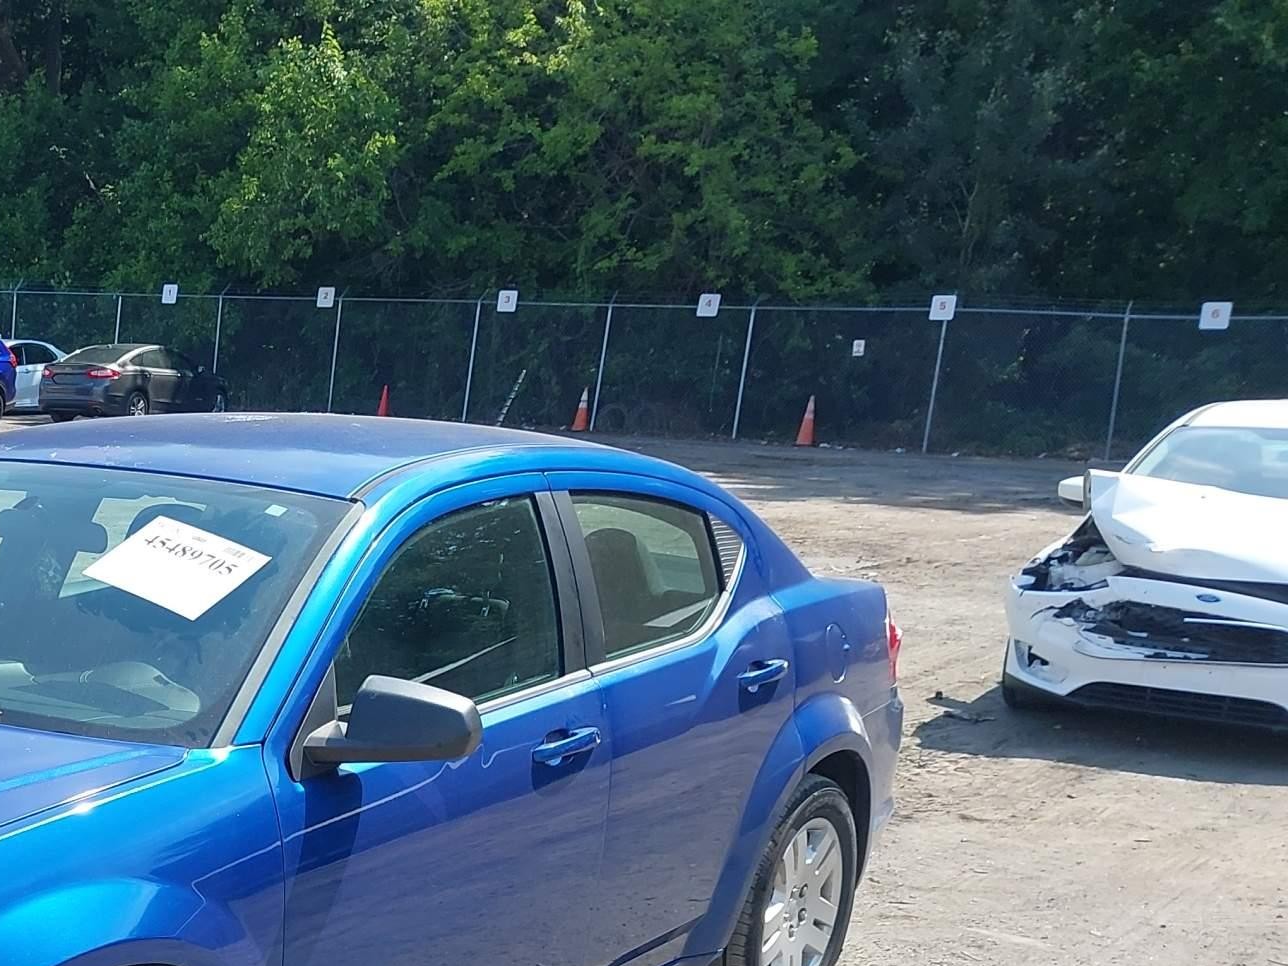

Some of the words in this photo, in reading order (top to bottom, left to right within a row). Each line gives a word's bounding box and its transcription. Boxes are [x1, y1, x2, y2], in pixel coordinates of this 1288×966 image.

[939, 301, 947, 310] 5
[1211, 309, 1220, 319] 6
[144, 535, 238, 575] 45489705
